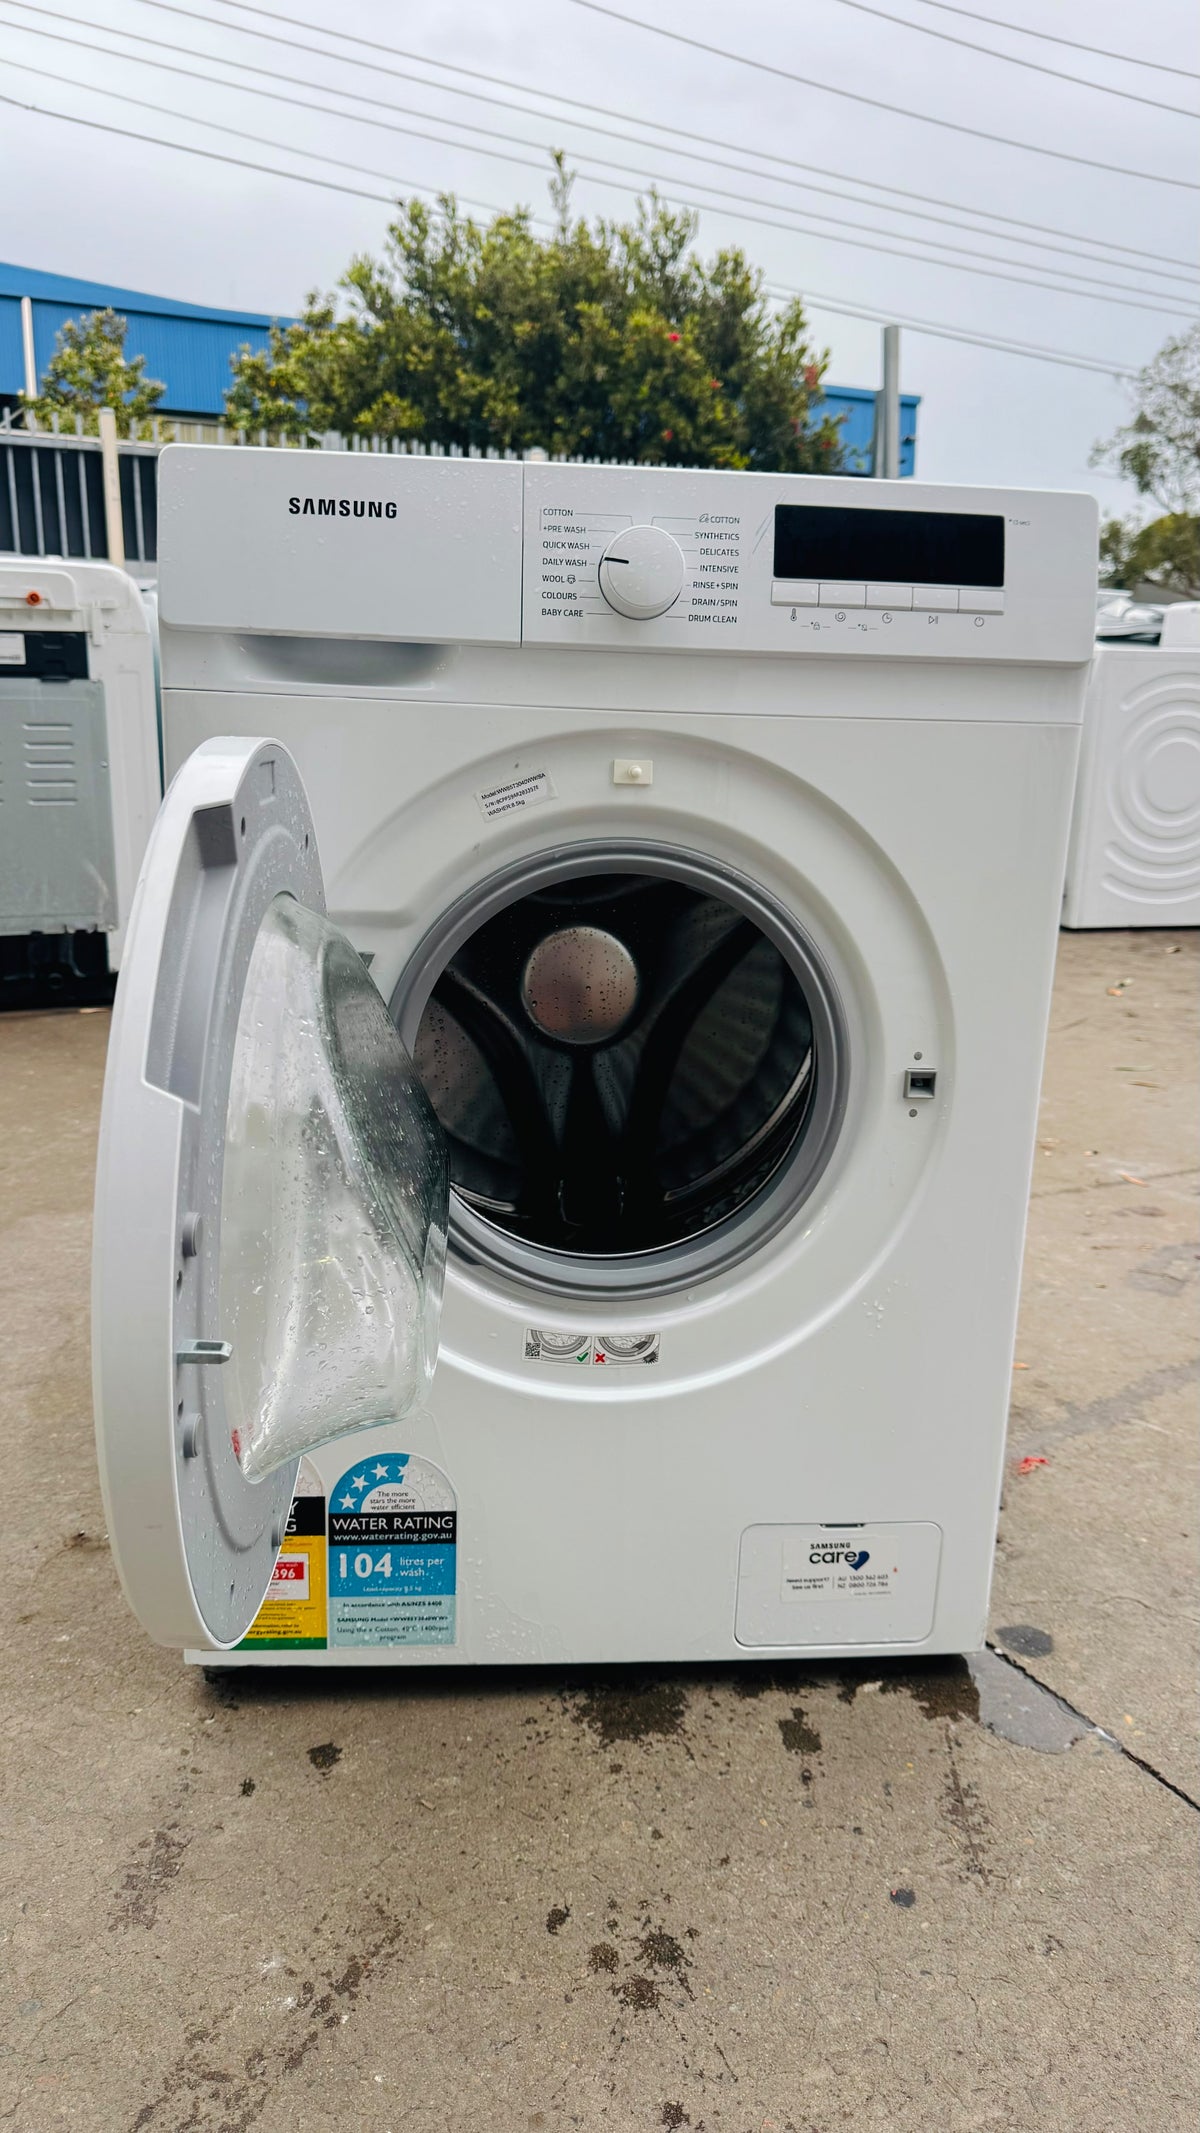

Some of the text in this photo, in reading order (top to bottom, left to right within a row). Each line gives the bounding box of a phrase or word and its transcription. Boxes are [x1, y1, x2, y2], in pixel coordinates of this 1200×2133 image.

[288, 497, 398, 519] SAMSUNG
[543, 508, 574, 517] COTTON
[710, 516, 740, 524] COTTON
[564, 526, 586, 534] WASH
[694, 531, 740, 541] SYNTHETICS
[542, 541, 590, 550] QUICK WASH
[700, 547, 740, 557] DELICATES
[542, 557, 587, 567] DAILY WASH
[700, 564, 739, 573] INTENSIVE
[541, 574, 565, 583] WOOL
[541, 591, 578, 600] COLOURS
[541, 608, 584, 618] BABY CARE
[688, 614, 738, 624] DRUM CLEAN
[332, 1516, 454, 1530] WATER RATING
[333, 1531, 453, 1542] www.waterrating.gov.au
[810, 1542, 851, 1550] SAMSUNG
[809, 1551, 857, 1564] care
[339, 1552, 445, 1578] 104 litres per
[400, 1567, 425, 1577] wash
